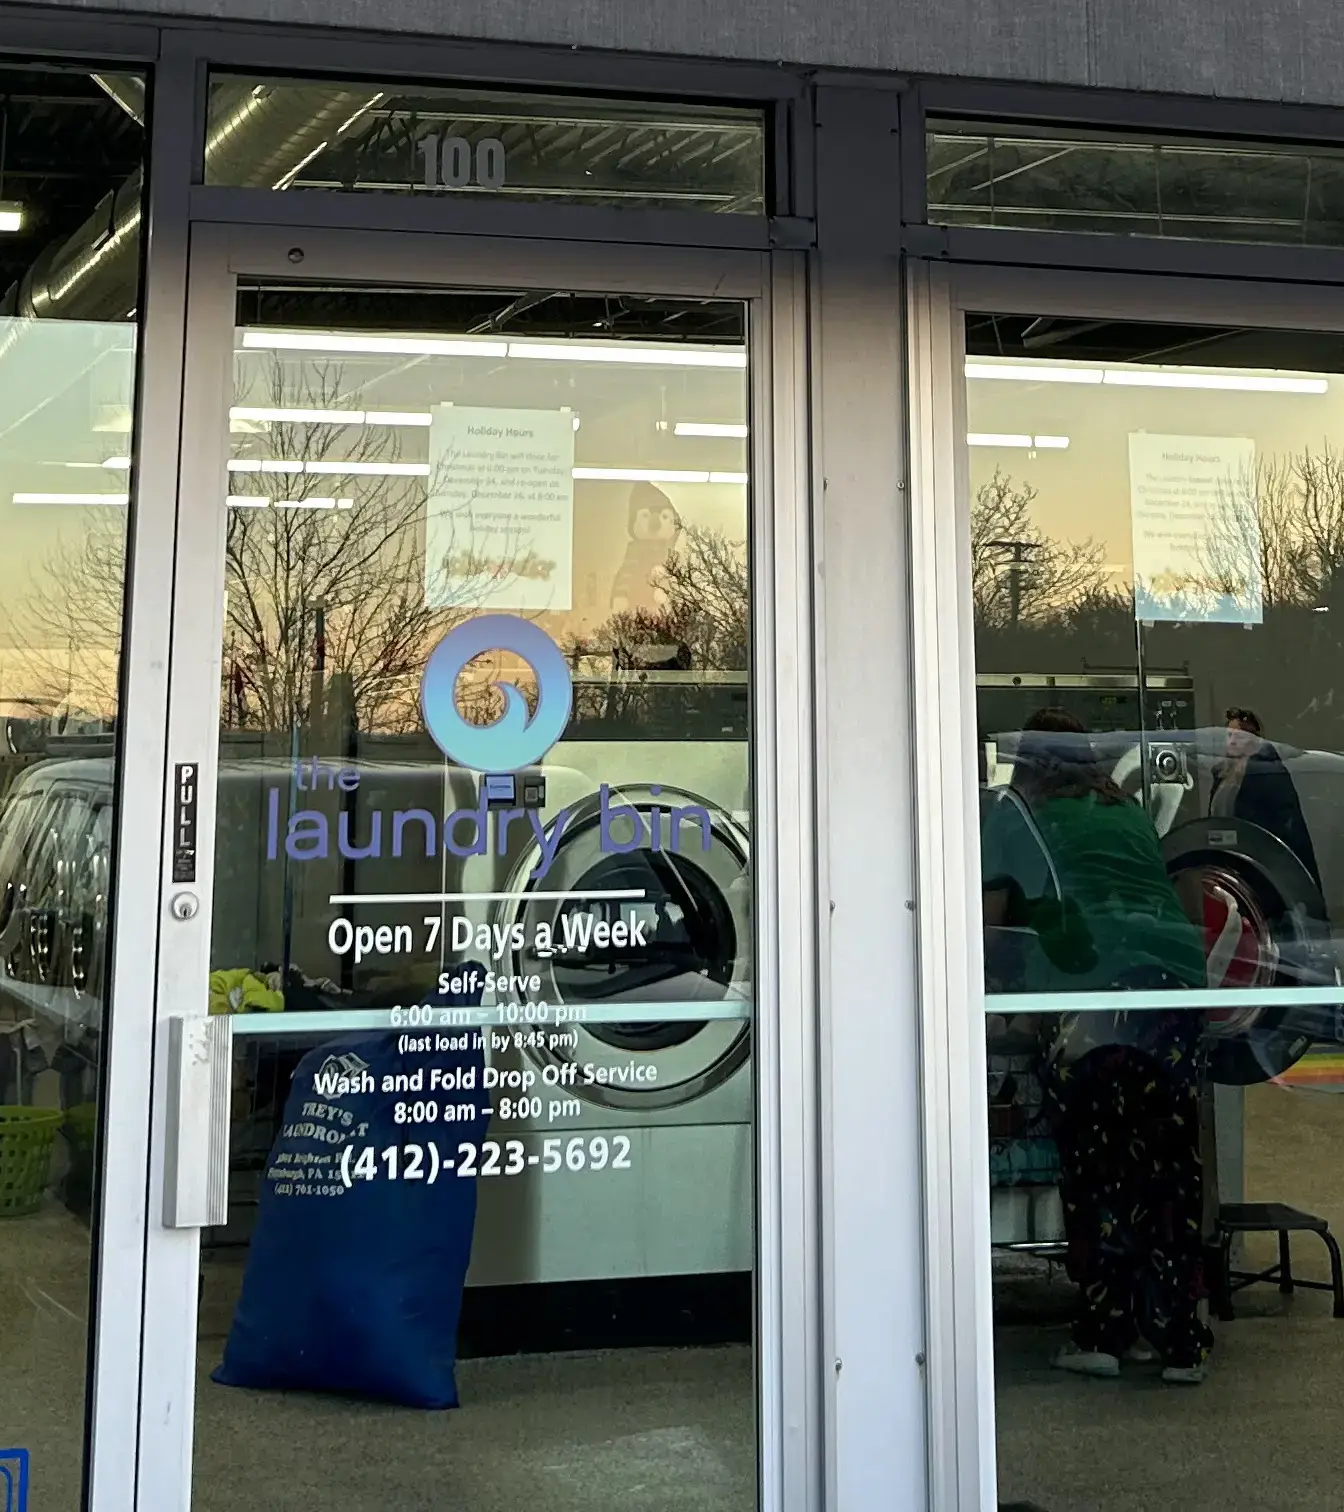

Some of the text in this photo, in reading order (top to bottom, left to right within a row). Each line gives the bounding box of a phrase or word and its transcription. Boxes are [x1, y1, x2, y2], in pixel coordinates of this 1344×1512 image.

[417, 134, 506, 188] 100
[296, 755, 360, 791] the
[179, 766, 194, 847] PULL
[266, 783, 711, 879] laundry bin
[328, 910, 648, 963] Open 7 Days a Week
[438, 972, 541, 995] Self-Serve
[390, 1005, 433, 1027] 6:00
[439, 1008, 471, 1025] am
[496, 1001, 549, 1023] 10:00
[555, 1005, 588, 1027] pm
[398, 1029, 579, 1054] (last load in by 8:45 pm)
[314, 1060, 658, 1095] Wash and Fold Drop Off Service
[394, 1100, 438, 1124] 8:00
[444, 1102, 476, 1122] am
[499, 1097, 543, 1119] 8:00
[548, 1098, 581, 1123] pm
[340, 1135, 633, 1188] (412)-223-5692
